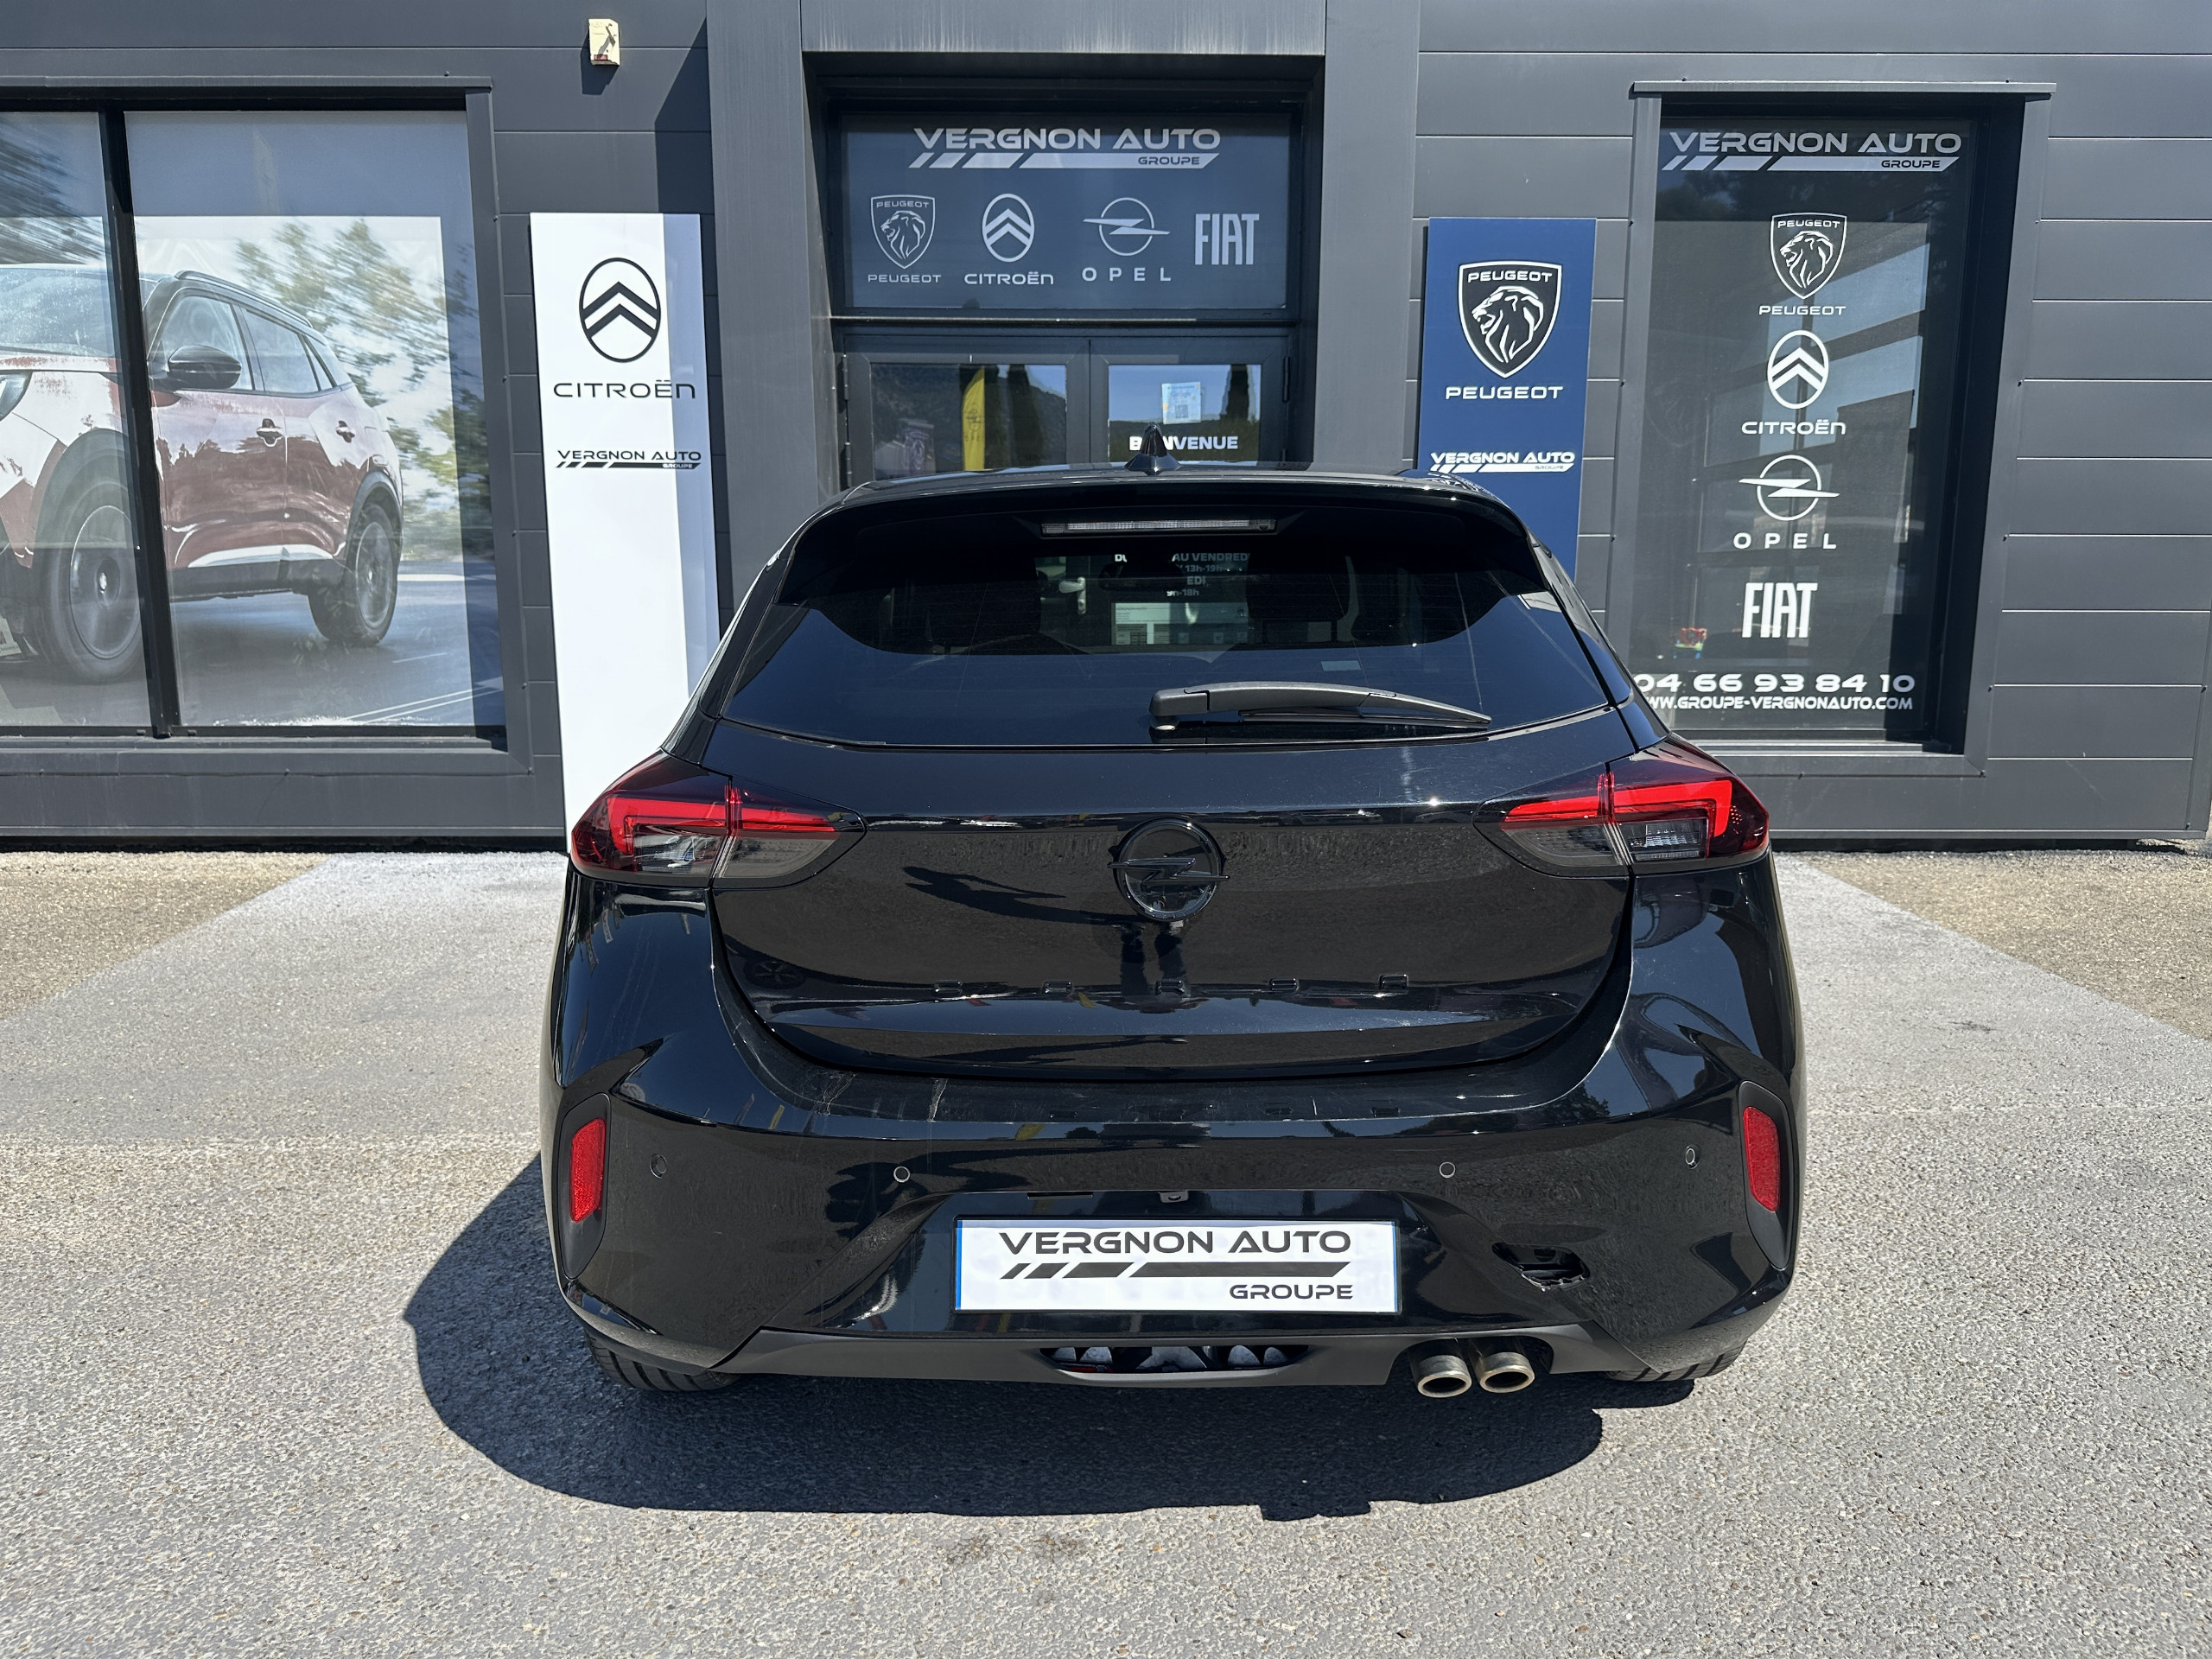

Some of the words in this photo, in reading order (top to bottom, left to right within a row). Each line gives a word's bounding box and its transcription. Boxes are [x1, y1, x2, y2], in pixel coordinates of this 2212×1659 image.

[913, 128, 1101, 149] VERGNON
[1112, 128, 1221, 149] AUTO
[1669, 132, 1847, 153] VERGNON
[1858, 133, 1962, 154] AUTO
[1137, 156, 1200, 166] GROUPE
[1880, 159, 1941, 168] GROUPE
[1777, 219, 1840, 228] PEUGEOT
[1195, 213, 1260, 265] FIAT
[868, 274, 942, 283] PEUGEOT
[1467, 270, 1553, 283] PEUGEOT
[1758, 305, 1847, 315] PEUGEOT
[1446, 386, 1564, 400] PEUGEOT
[1128, 435, 1239, 451] BNVENUE
[557, 450, 645, 461] VERGNON
[651, 450, 702, 461] AUTO
[1430, 452, 1519, 464] VERGNON
[1522, 452, 1575, 463] AUTO
[1171, 552, 1189, 562] AU
[1741, 582, 1818, 639] FIAT
[1633, 673, 1682, 692] 04
[1693, 673, 1743, 692] 66
[1754, 673, 1805, 693] 93
[1815, 673, 1867, 693] 84
[1879, 673, 1915, 693] 10
[1645, 696, 1913, 710] WW.GROUPE-VERGNONAUTO.COM
[999, 1230, 1213, 1255] VERGNON
[1228, 1230, 1351, 1254] AUTO
[1229, 1284, 1353, 1300] GROUPE
